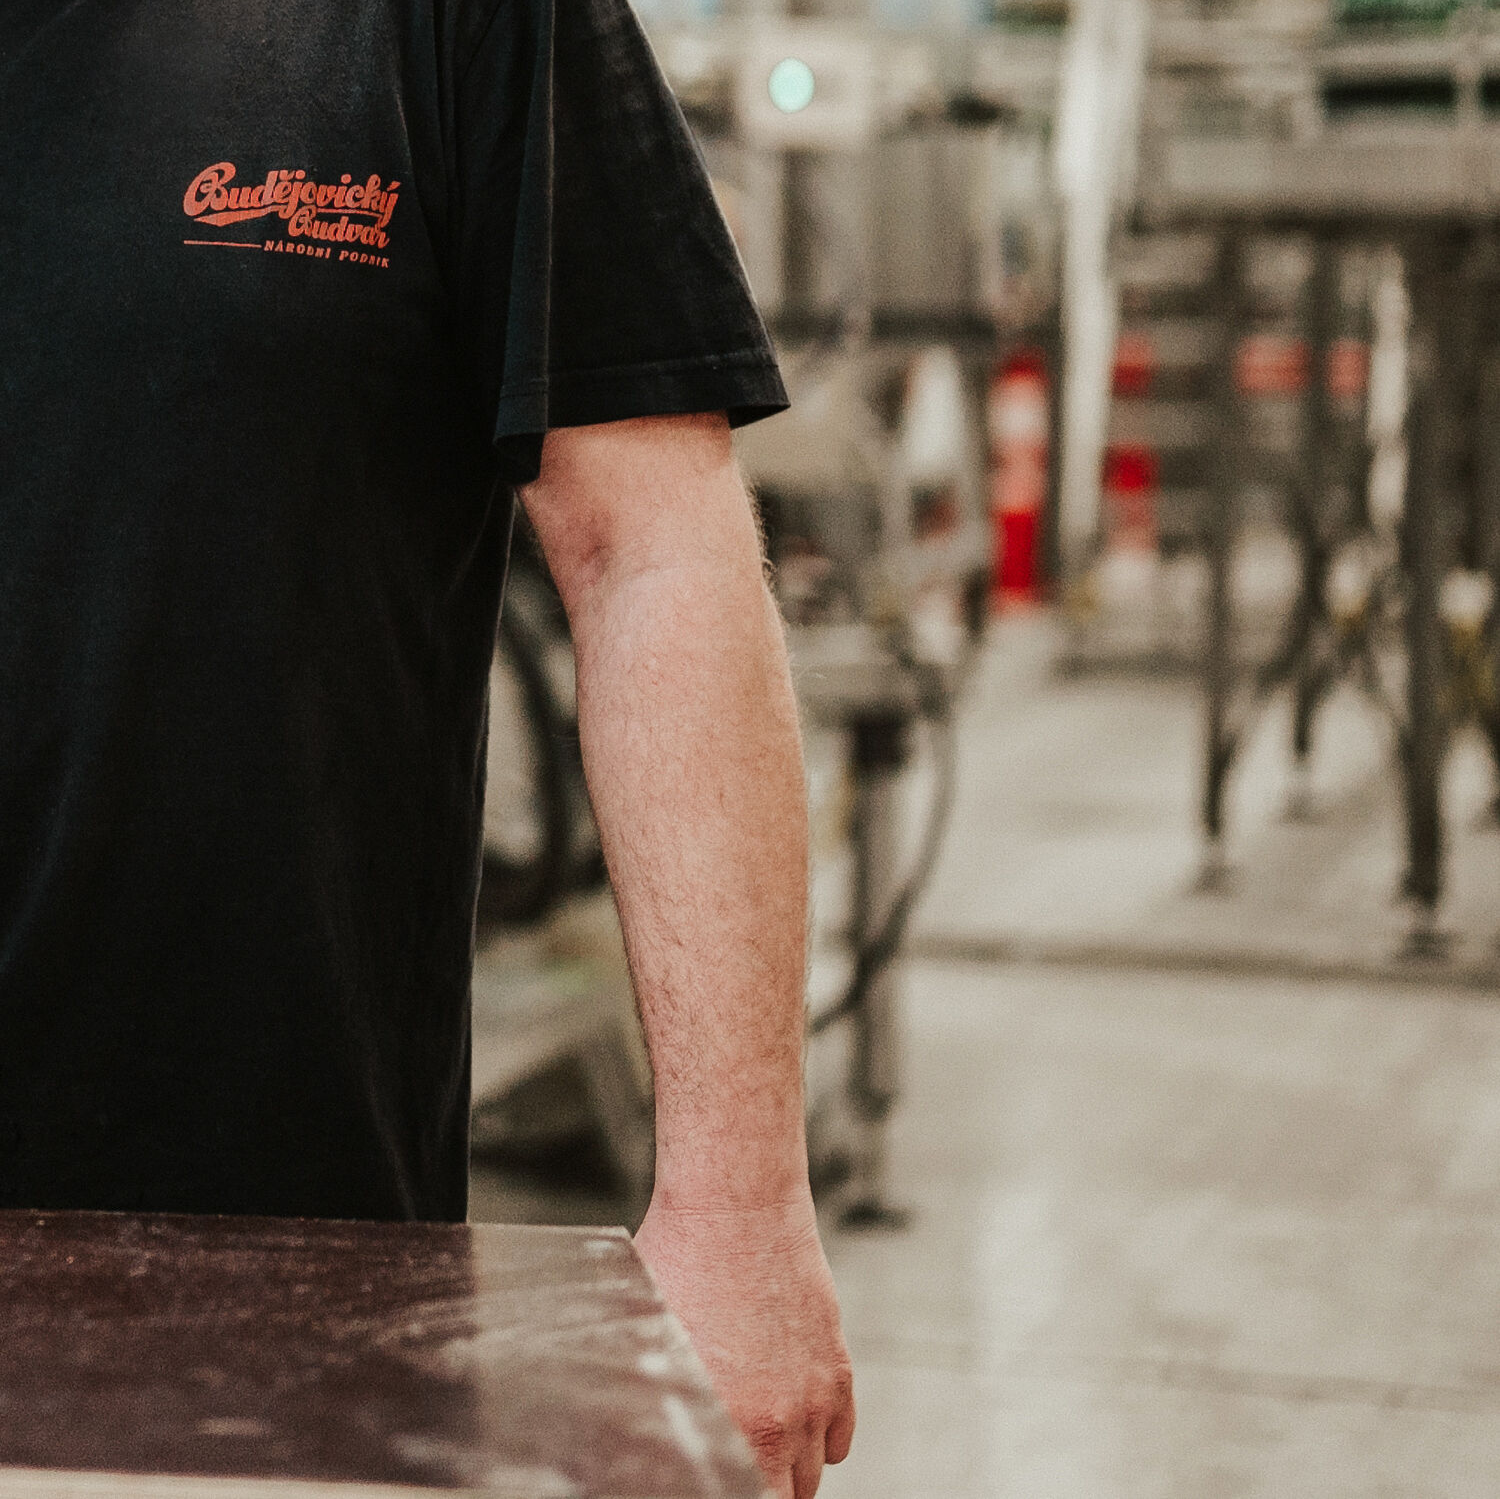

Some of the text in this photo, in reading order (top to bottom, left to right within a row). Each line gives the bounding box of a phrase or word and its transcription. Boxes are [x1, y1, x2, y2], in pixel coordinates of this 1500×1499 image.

[183, 161, 400, 228] Budějovický
[288, 205, 391, 249] Budvar
[339, 250, 390, 268] PODNIK
